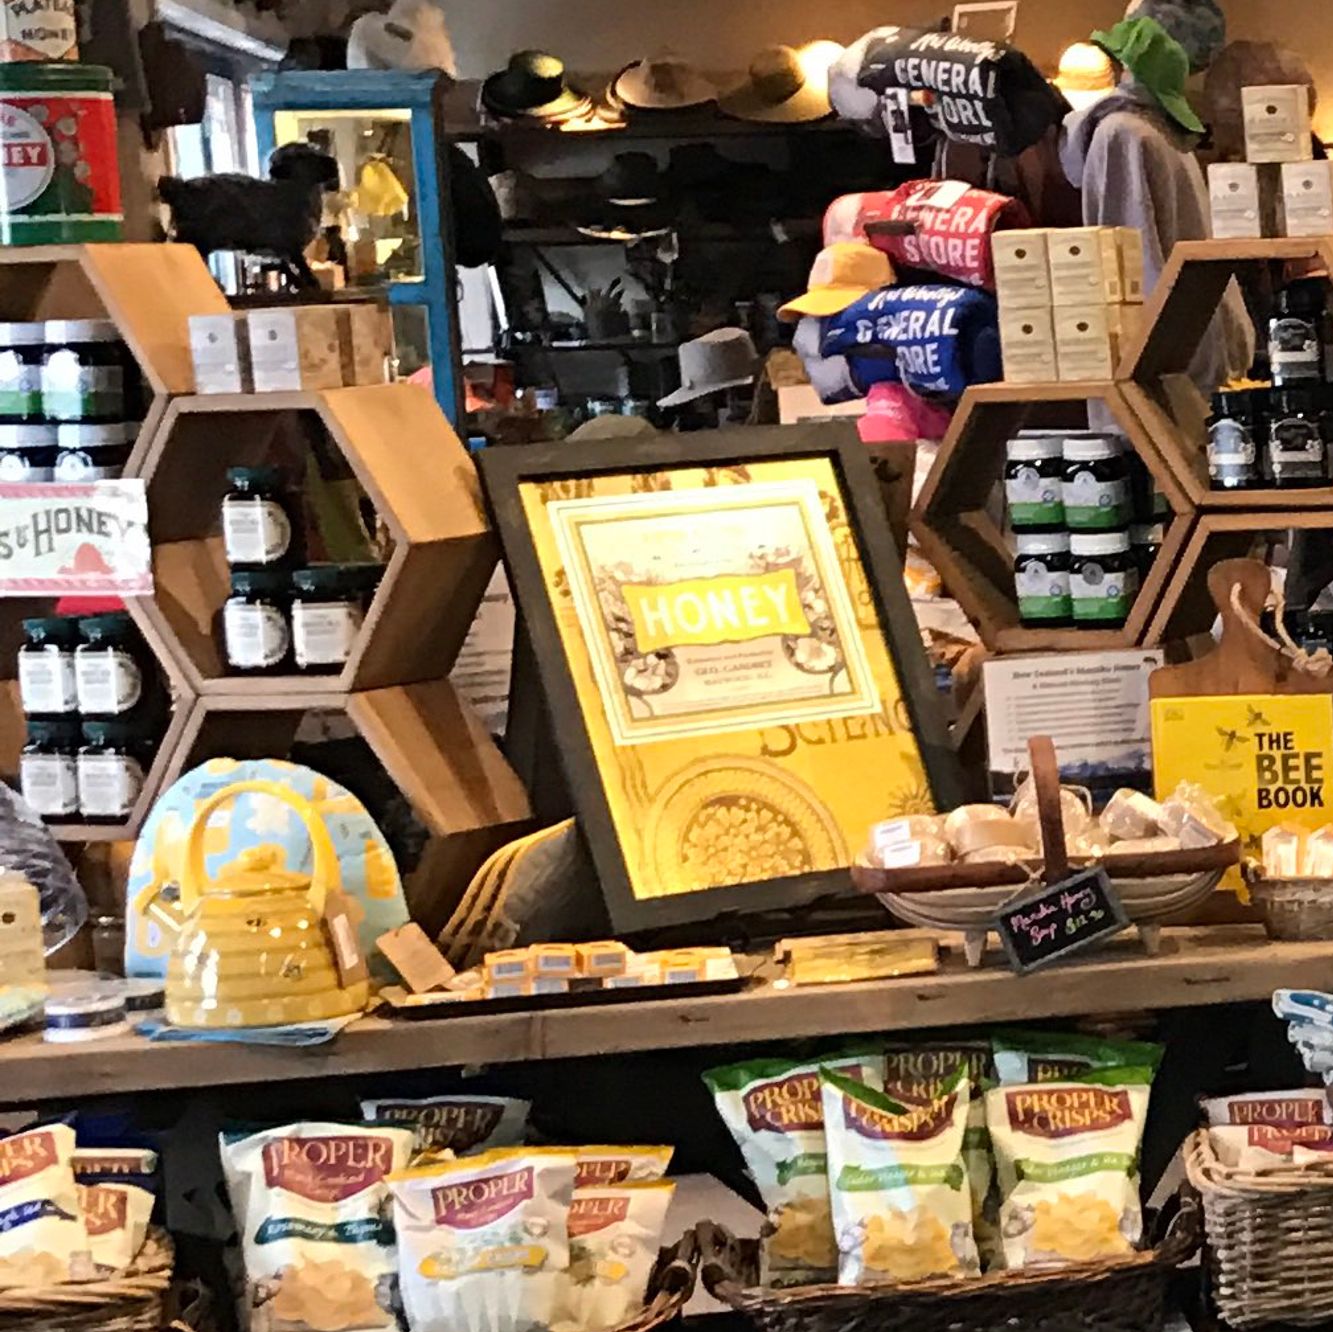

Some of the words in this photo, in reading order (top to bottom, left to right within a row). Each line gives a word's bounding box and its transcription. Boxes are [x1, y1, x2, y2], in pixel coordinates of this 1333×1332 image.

[640, 582, 791, 637] HONEY
[1254, 731, 1295, 752] THE
[1255, 751, 1324, 787] BEE
[1256, 785, 1325, 810] BOOK
[1015, 1090, 1123, 1121] PROPER
[435, 1170, 529, 1217] PROPER
